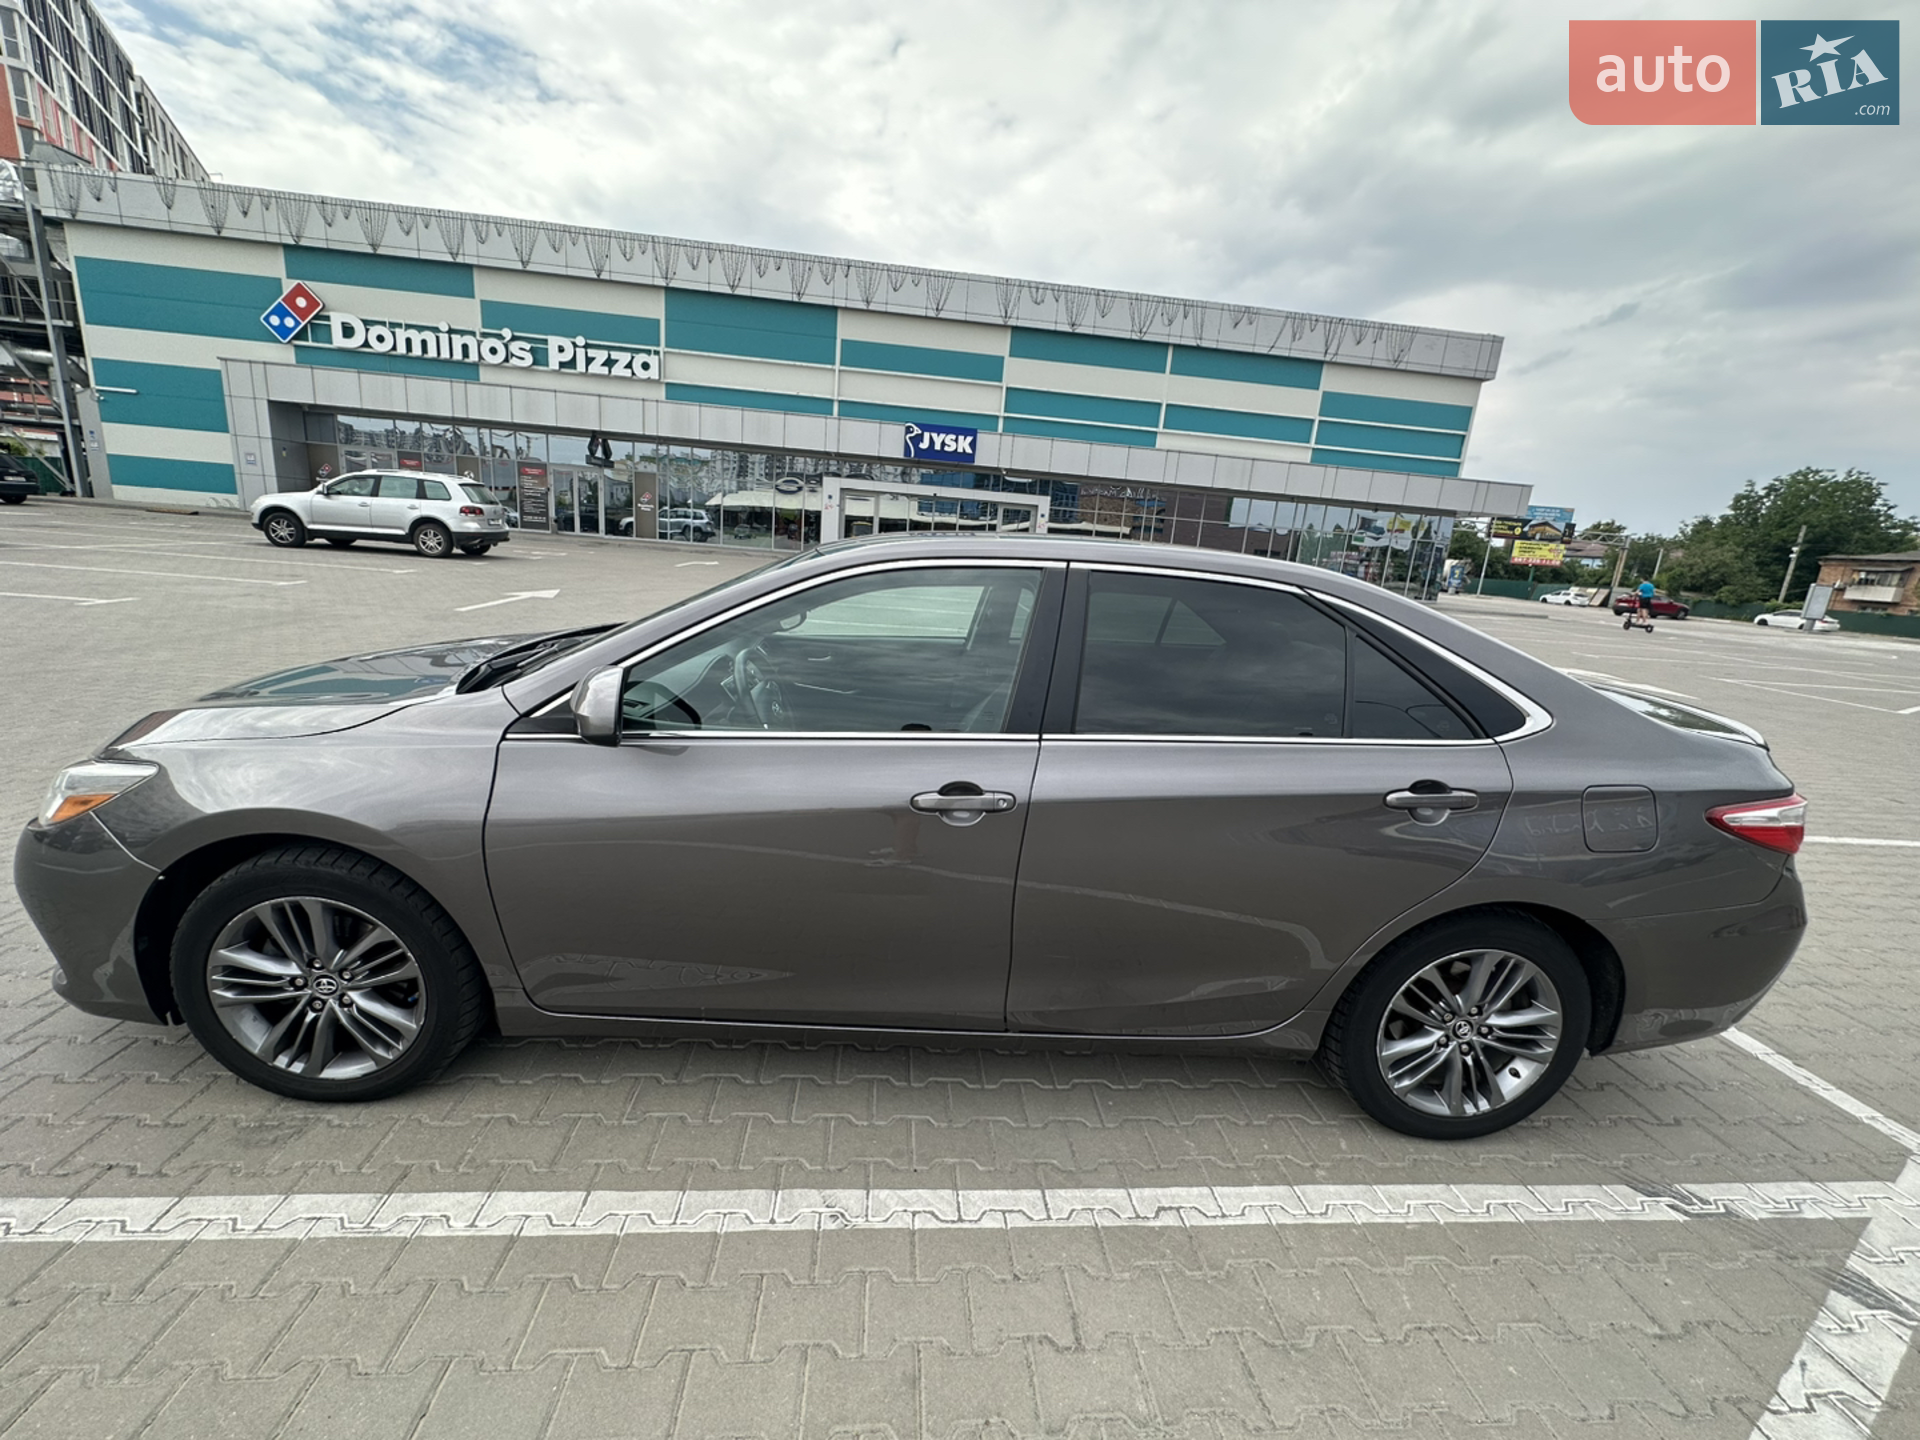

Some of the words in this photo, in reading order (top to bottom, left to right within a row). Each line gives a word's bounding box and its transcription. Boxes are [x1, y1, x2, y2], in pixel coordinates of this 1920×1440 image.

[330, 311, 534, 368] Domino's
[548, 334, 661, 381] Pizza
[918, 431, 974, 454] JYSK
